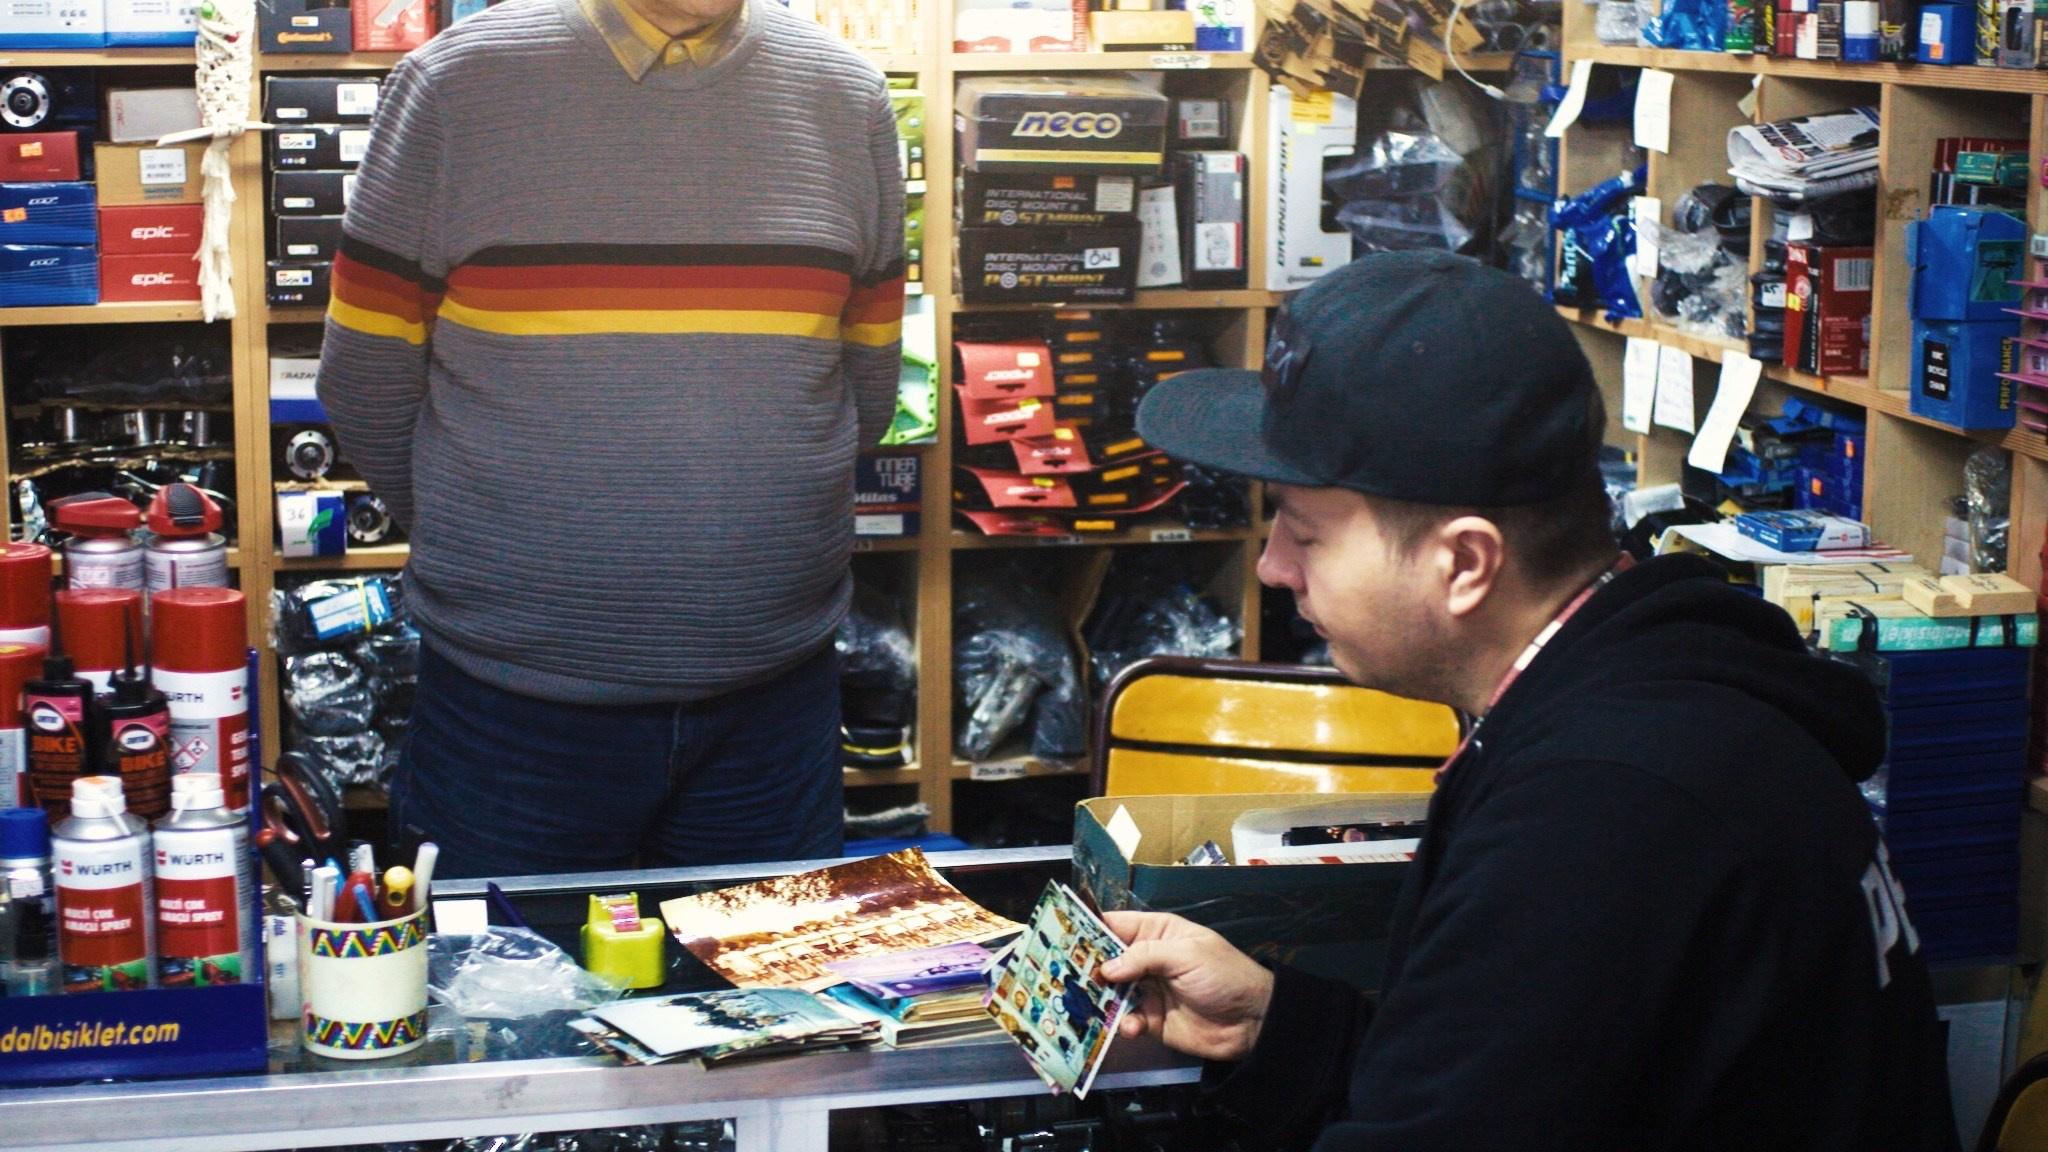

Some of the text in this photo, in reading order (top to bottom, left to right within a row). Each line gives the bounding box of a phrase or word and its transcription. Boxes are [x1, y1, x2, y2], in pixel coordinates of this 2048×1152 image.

[1011, 111, 1122, 139] neco
[984, 200, 1017, 209] DISC
[1021, 201, 1067, 210] MOUNT
[131, 226, 174, 240] epic
[985, 253, 1085, 262] INTERNATIONA
[984, 263, 1017, 272] DISC
[1021, 263, 1067, 272] MOUNT
[131, 273, 174, 287] epic
[1999, 338, 2013, 410] PERFOMANCE
[0, 1021, 179, 1052] dalbisiklet.com
